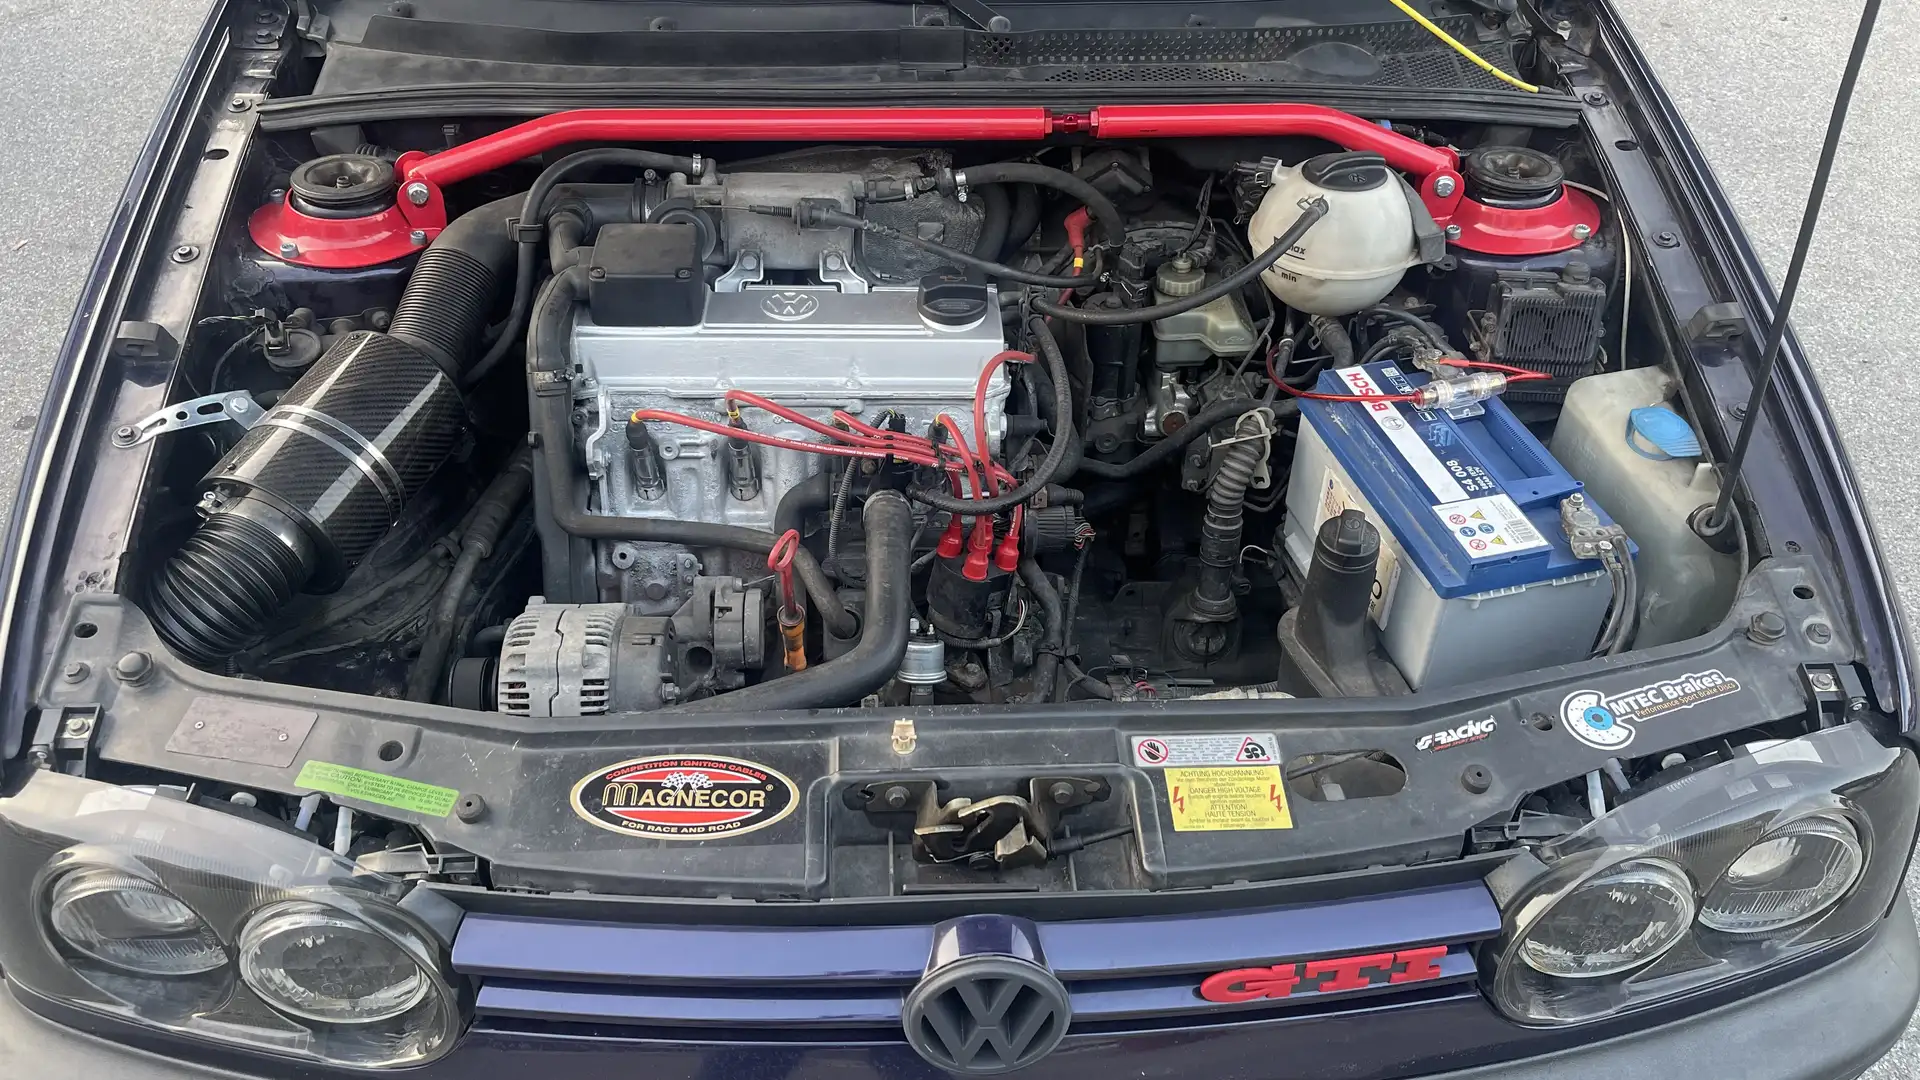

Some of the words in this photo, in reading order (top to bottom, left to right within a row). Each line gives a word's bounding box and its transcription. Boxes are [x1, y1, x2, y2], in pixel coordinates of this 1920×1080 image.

[1281, 272, 1297, 283] min
[1346, 372, 1389, 412] BSCH
[1446, 459, 1467, 477] 008
[1461, 478, 1479, 491] S4
[1608, 689, 1663, 717] MTEC
[1660, 673, 1723, 700] Brakes
[1636, 699, 1680, 717] Performance
[1680, 693, 1698, 705] Sport
[1699, 687, 1718, 698] Brake
[1719, 682, 1736, 692] Discs
[605, 760, 678, 781] COMPETITION
[680, 760, 727, 770] IGNITION
[728, 764, 767, 781] CABLES
[1180, 770, 1210, 778] ACHTUNG
[1211, 769, 1265, 777] HOCHSPANNUNG
[1234, 786, 1261, 794] VOLTAGE
[621, 820, 645, 831] FOR
[648, 823, 678, 833] RACE
[681, 824, 705, 833] AND
[710, 821, 741, 832] ROAD
[1200, 945, 1448, 1003] GTI
